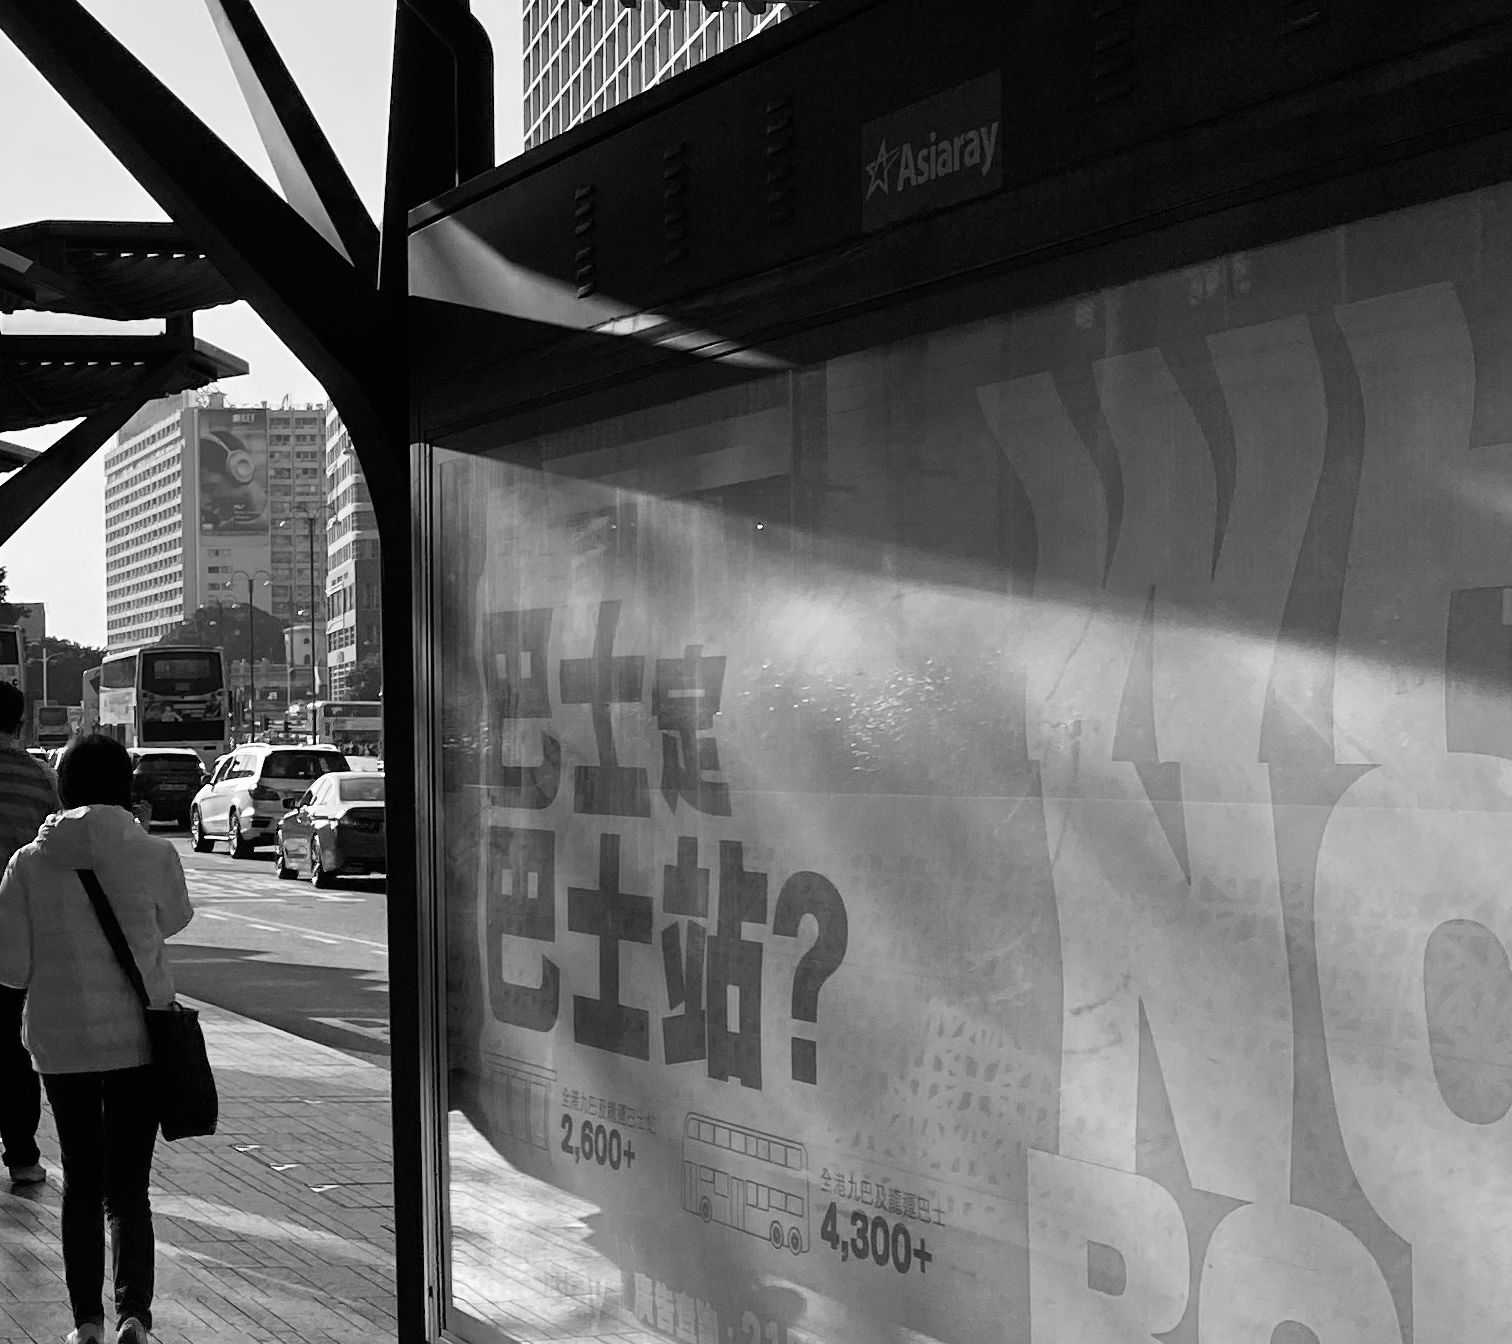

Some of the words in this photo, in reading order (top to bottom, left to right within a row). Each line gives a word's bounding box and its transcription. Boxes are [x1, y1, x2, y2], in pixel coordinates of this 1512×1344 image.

[896, 122, 1000, 193] Asiaray
[560, 1113, 637, 1171] 2,600+
[820, 1201, 933, 1274] 4,300+
